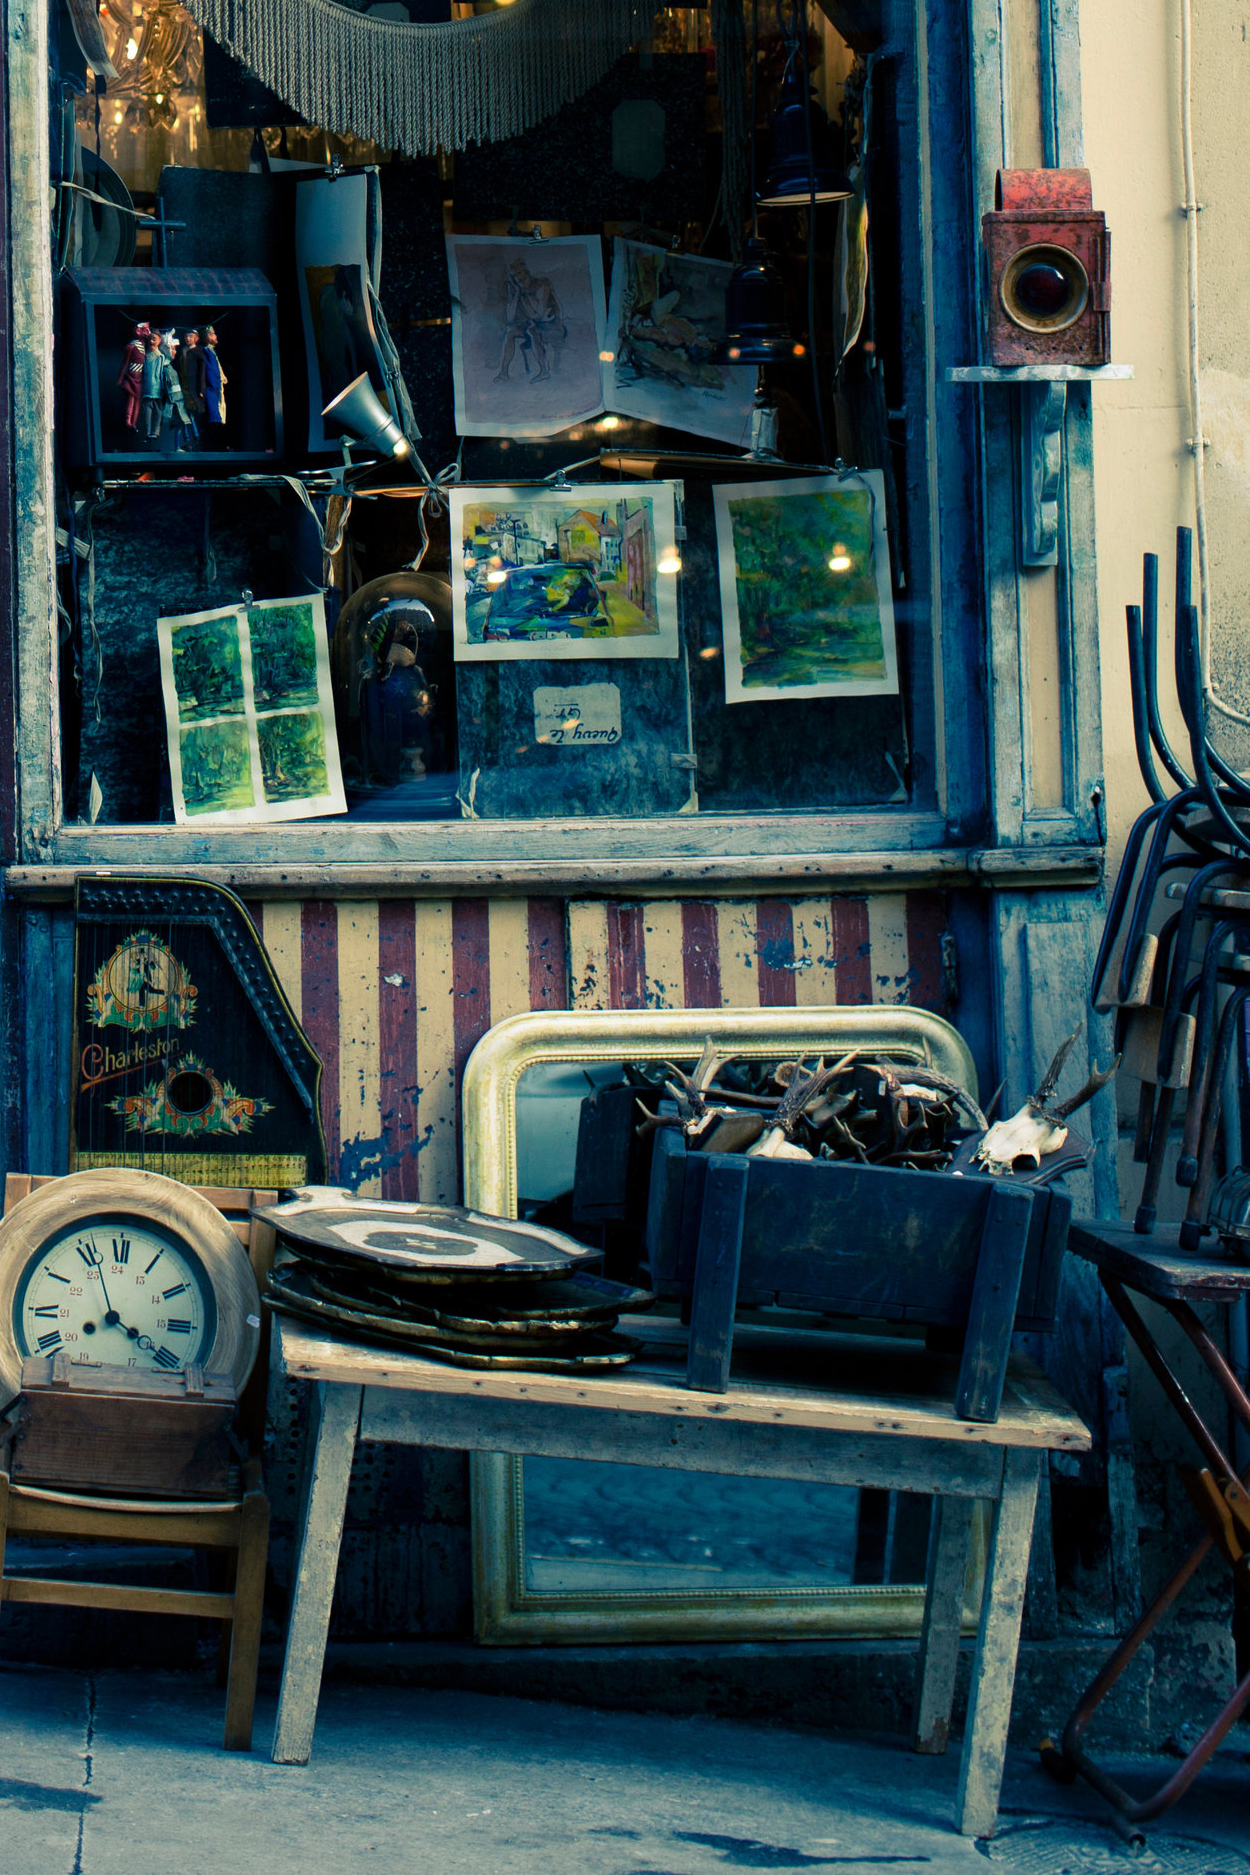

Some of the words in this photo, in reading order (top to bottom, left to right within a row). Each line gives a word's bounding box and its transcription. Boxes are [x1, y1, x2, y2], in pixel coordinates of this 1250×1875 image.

[81, 1038, 180, 1081] Charleston
[111, 1265, 124, 1275] 24
[136, 1276, 145, 1285] 13
[70, 1287, 83, 1296] 22
[151, 1295, 161, 1305] 14
[59, 1308, 70, 1318] 21
[156, 1319, 166, 1328] 15
[65, 1333, 78, 1342] 20
[127, 1357, 137, 1367] 17
